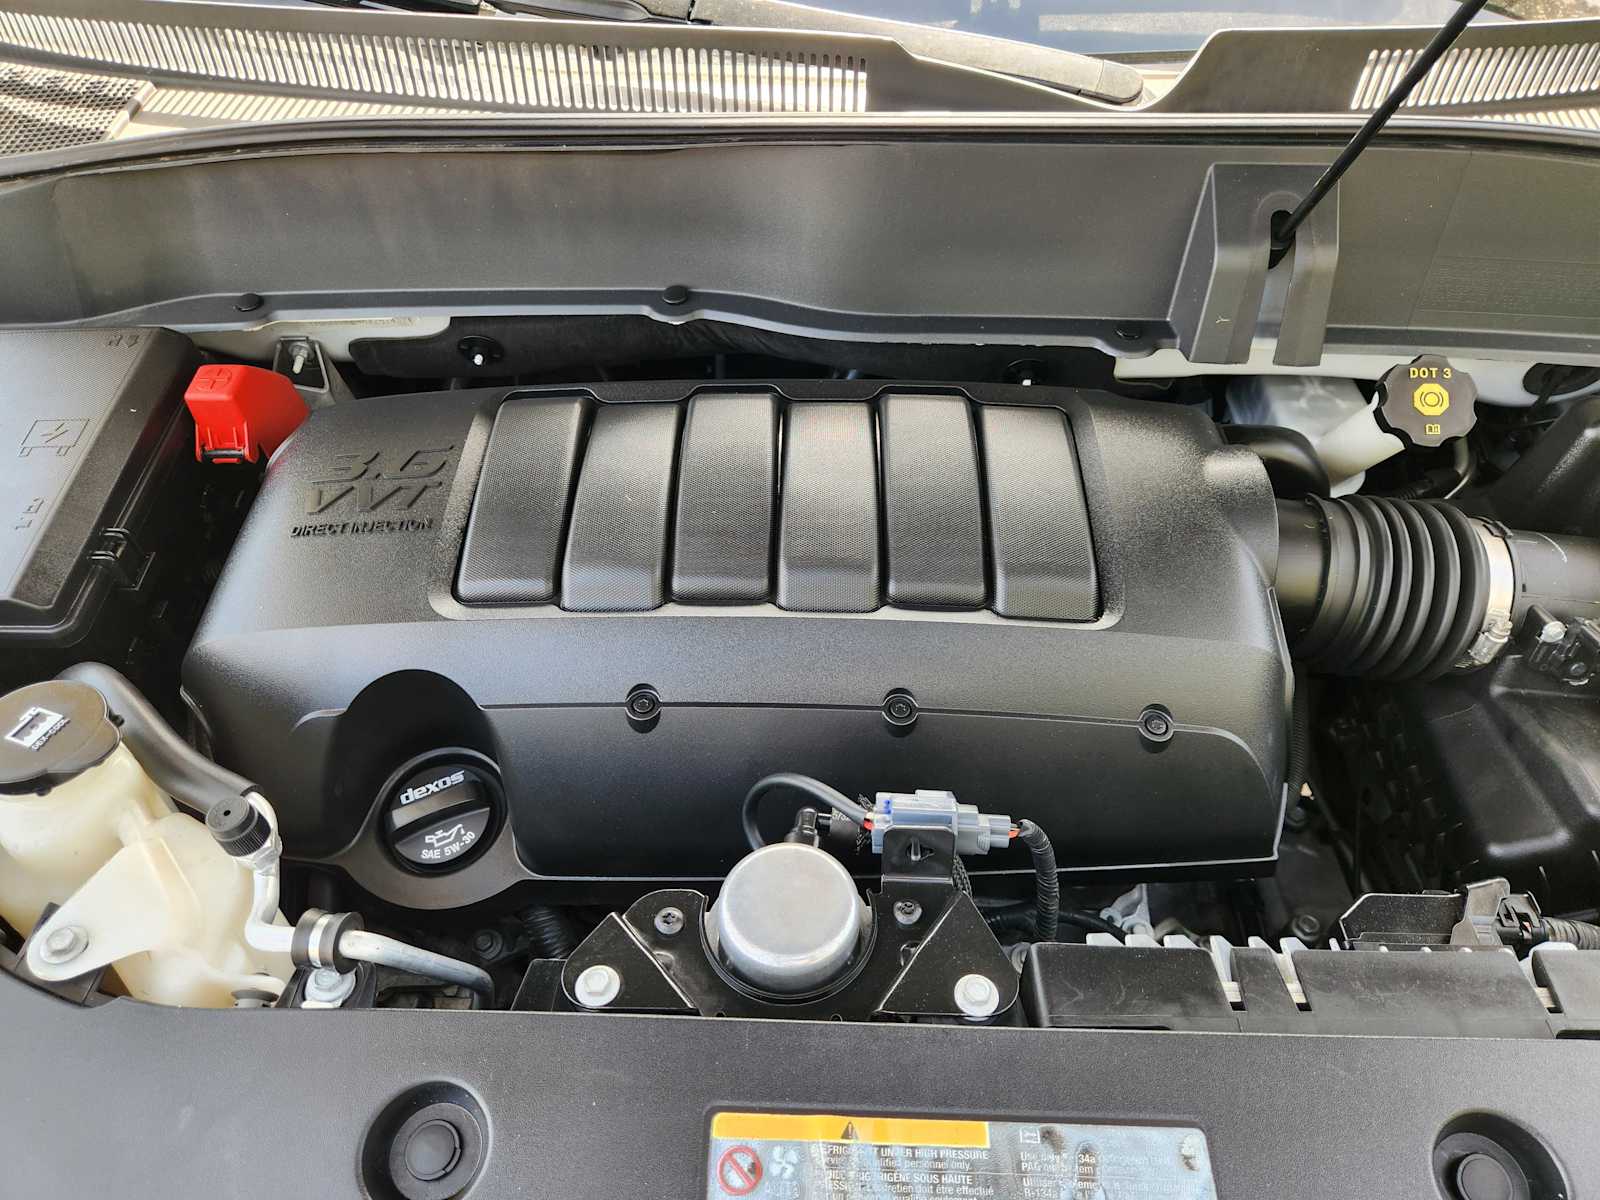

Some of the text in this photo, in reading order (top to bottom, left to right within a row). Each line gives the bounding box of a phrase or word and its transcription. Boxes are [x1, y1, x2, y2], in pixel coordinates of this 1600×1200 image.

[1409, 367, 1453, 379] DOT 3
[310, 445, 455, 484] 3.6
[305, 480, 443, 516] VVT
[290, 517, 435, 538] DIRECT INJECTION
[400, 770, 465, 805] dexos
[421, 831, 476, 860] SAE 5W-30
[915, 1149, 938, 1159] HIGH
[940, 1150, 989, 1161] PRESSURE
[914, 1173, 939, 1184] SOUS
[942, 1174, 972, 1185] HAUTE
